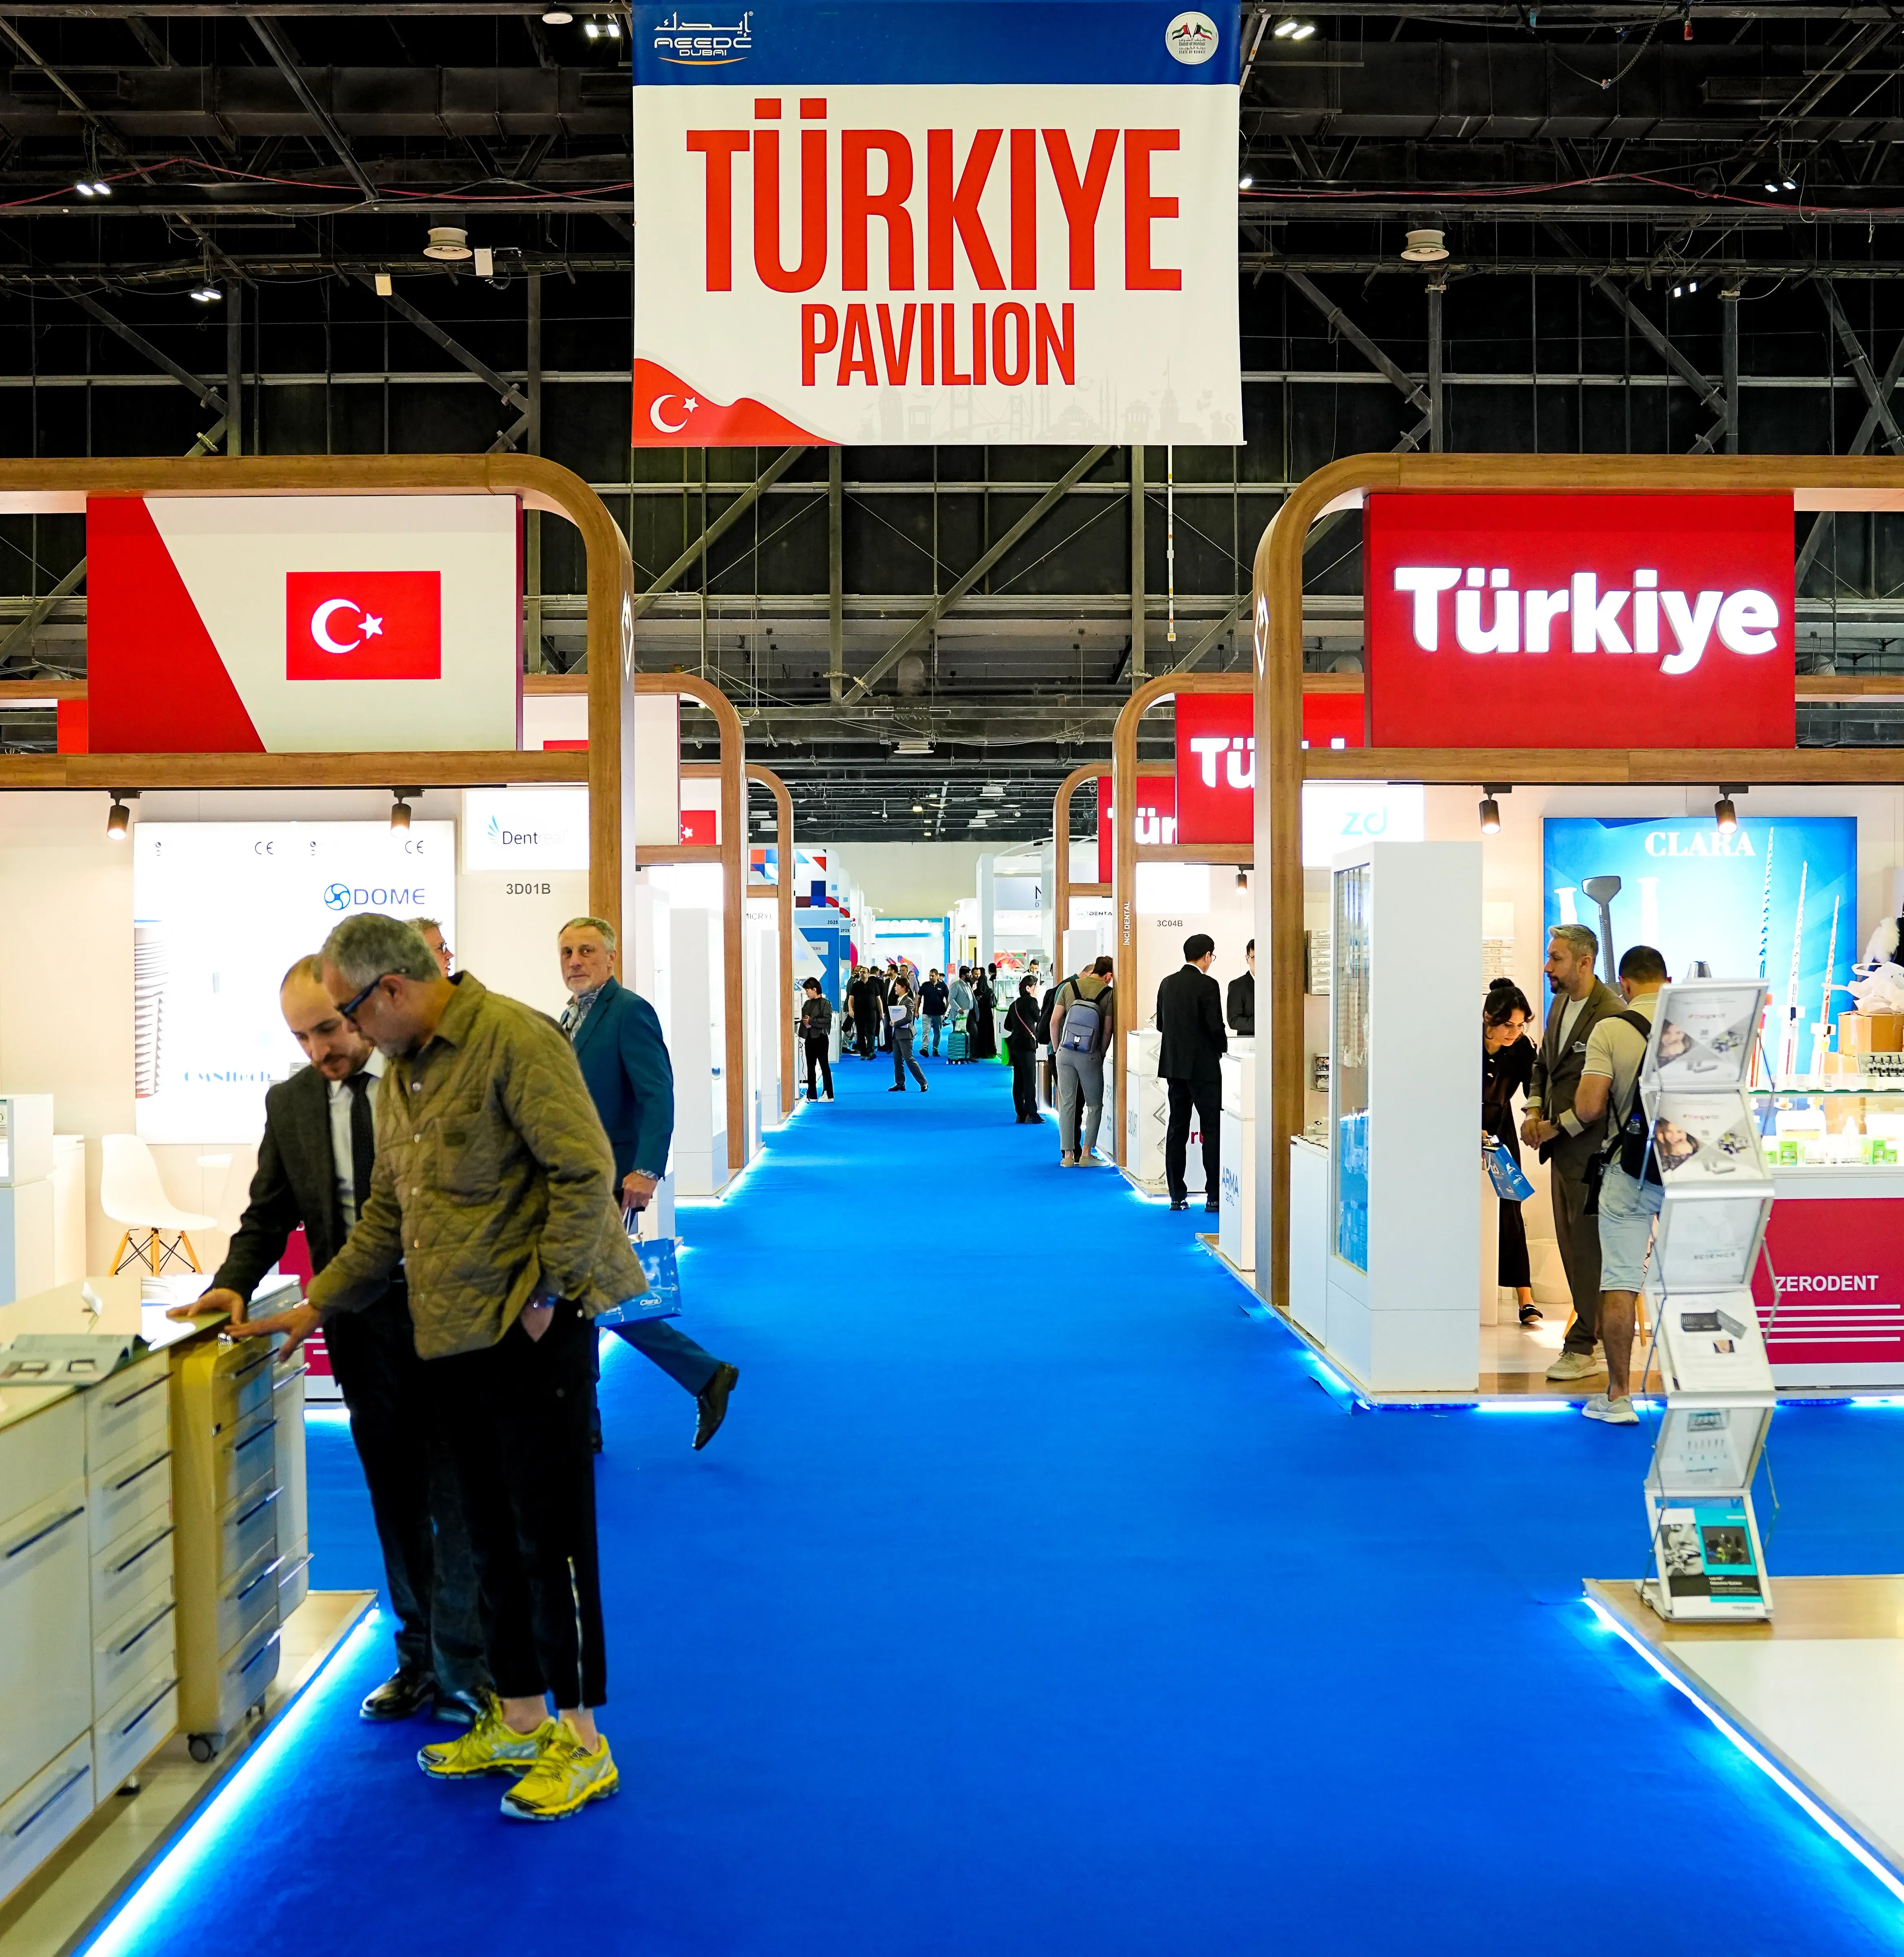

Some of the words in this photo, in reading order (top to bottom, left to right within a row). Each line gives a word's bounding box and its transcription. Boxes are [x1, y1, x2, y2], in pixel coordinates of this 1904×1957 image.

[654, 37, 751, 48] AEEDC
[687, 98, 1181, 293] TÜRKIYE
[801, 302, 1075, 386] PAVILION
[1394, 566, 1780, 676] Türkiye
[1645, 831, 1756, 856] CLARA
[354, 889, 425, 905] DOME
[506, 883, 551, 894] 3D01B
[1222, 1166, 1238, 1198] ARMA
[1775, 1275, 1879, 1292] ZERODENT
